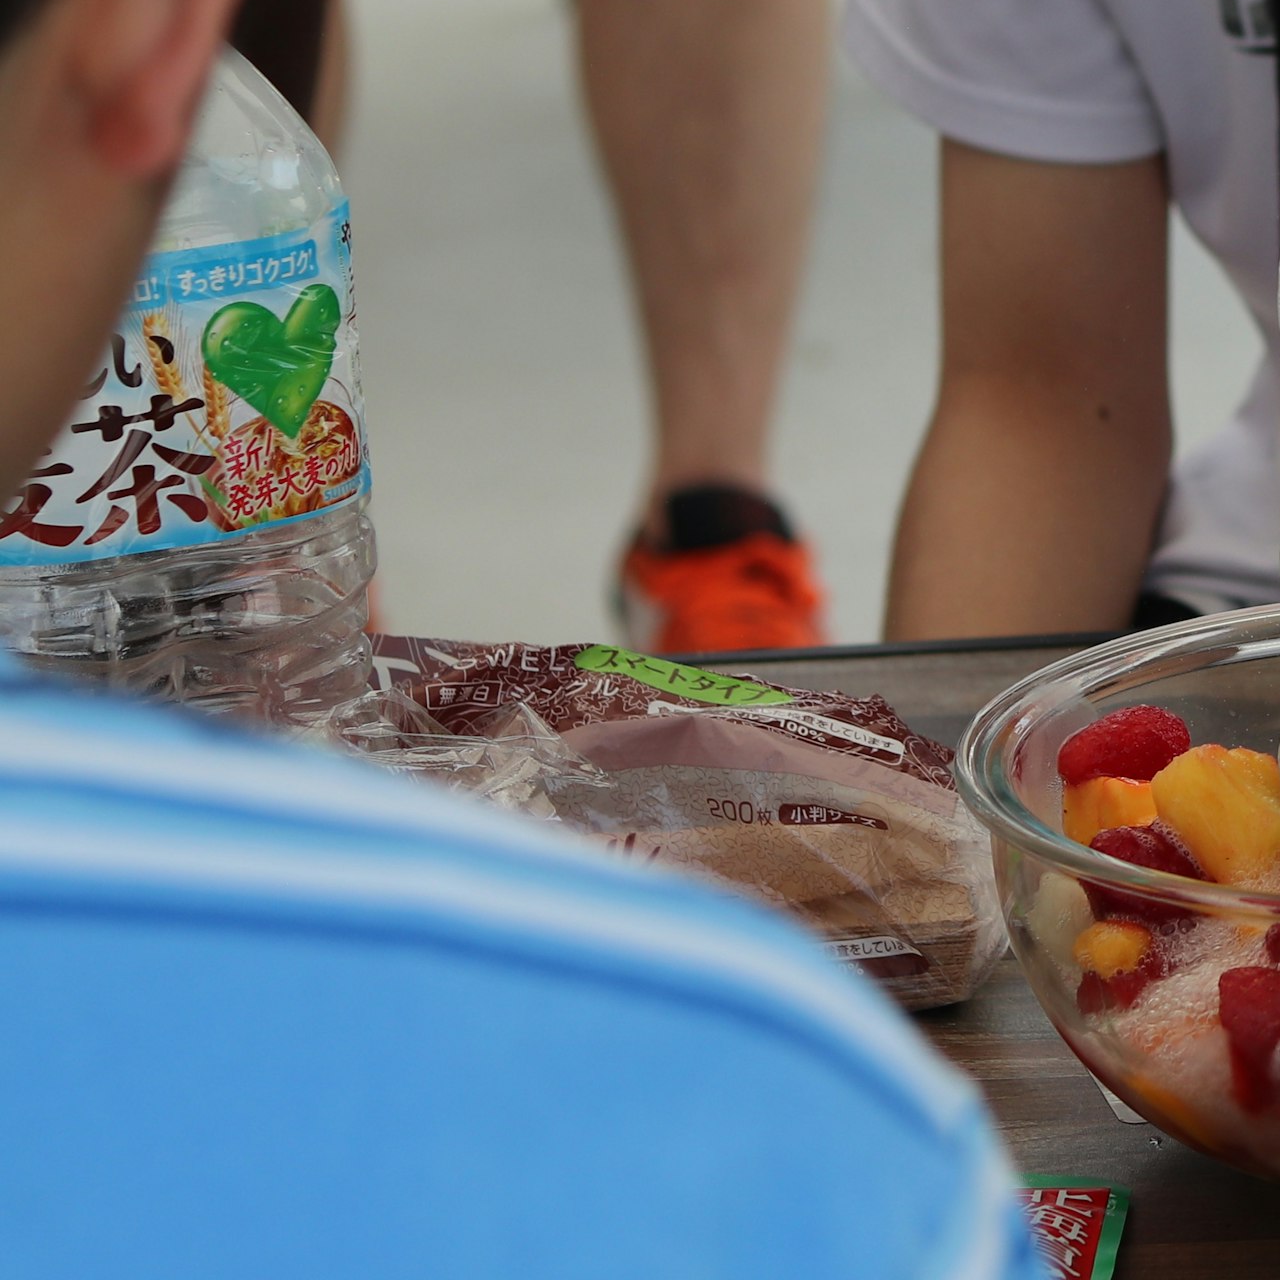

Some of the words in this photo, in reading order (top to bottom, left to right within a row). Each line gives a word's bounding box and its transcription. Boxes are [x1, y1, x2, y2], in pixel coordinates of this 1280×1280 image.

[176, 249, 315, 297] すっきりゴクゴク!
[224, 428, 273, 481] 新!
[446, 642, 567, 674] OWEL
[510, 677, 620, 706] シングル
